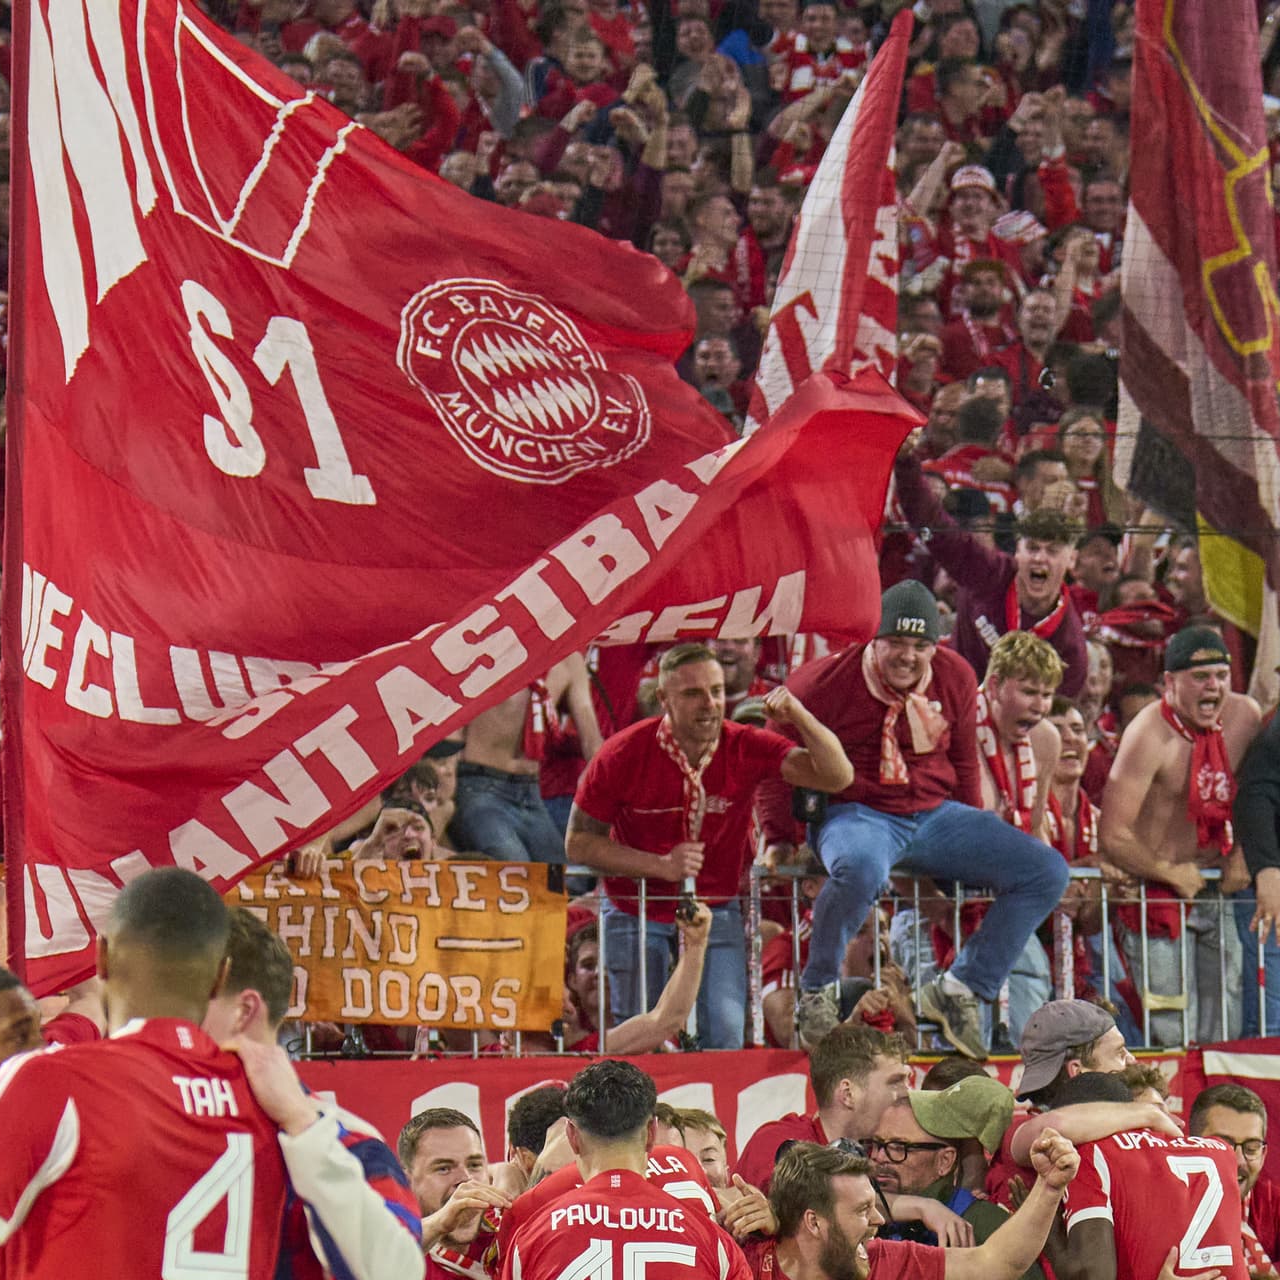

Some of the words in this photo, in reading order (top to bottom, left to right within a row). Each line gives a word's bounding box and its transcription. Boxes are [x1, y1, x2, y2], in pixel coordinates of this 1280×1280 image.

[438, 391, 607, 464] MÜNCHEN
[895, 616, 926, 633] 1972
[236, 858, 531, 913] ATCHES
[341, 966, 521, 1028] DOORS
[172, 1075, 239, 1118] TAH
[550, 1203, 686, 1233] PAVLOVIĆ
[1166, 1155, 1234, 1270] 2
